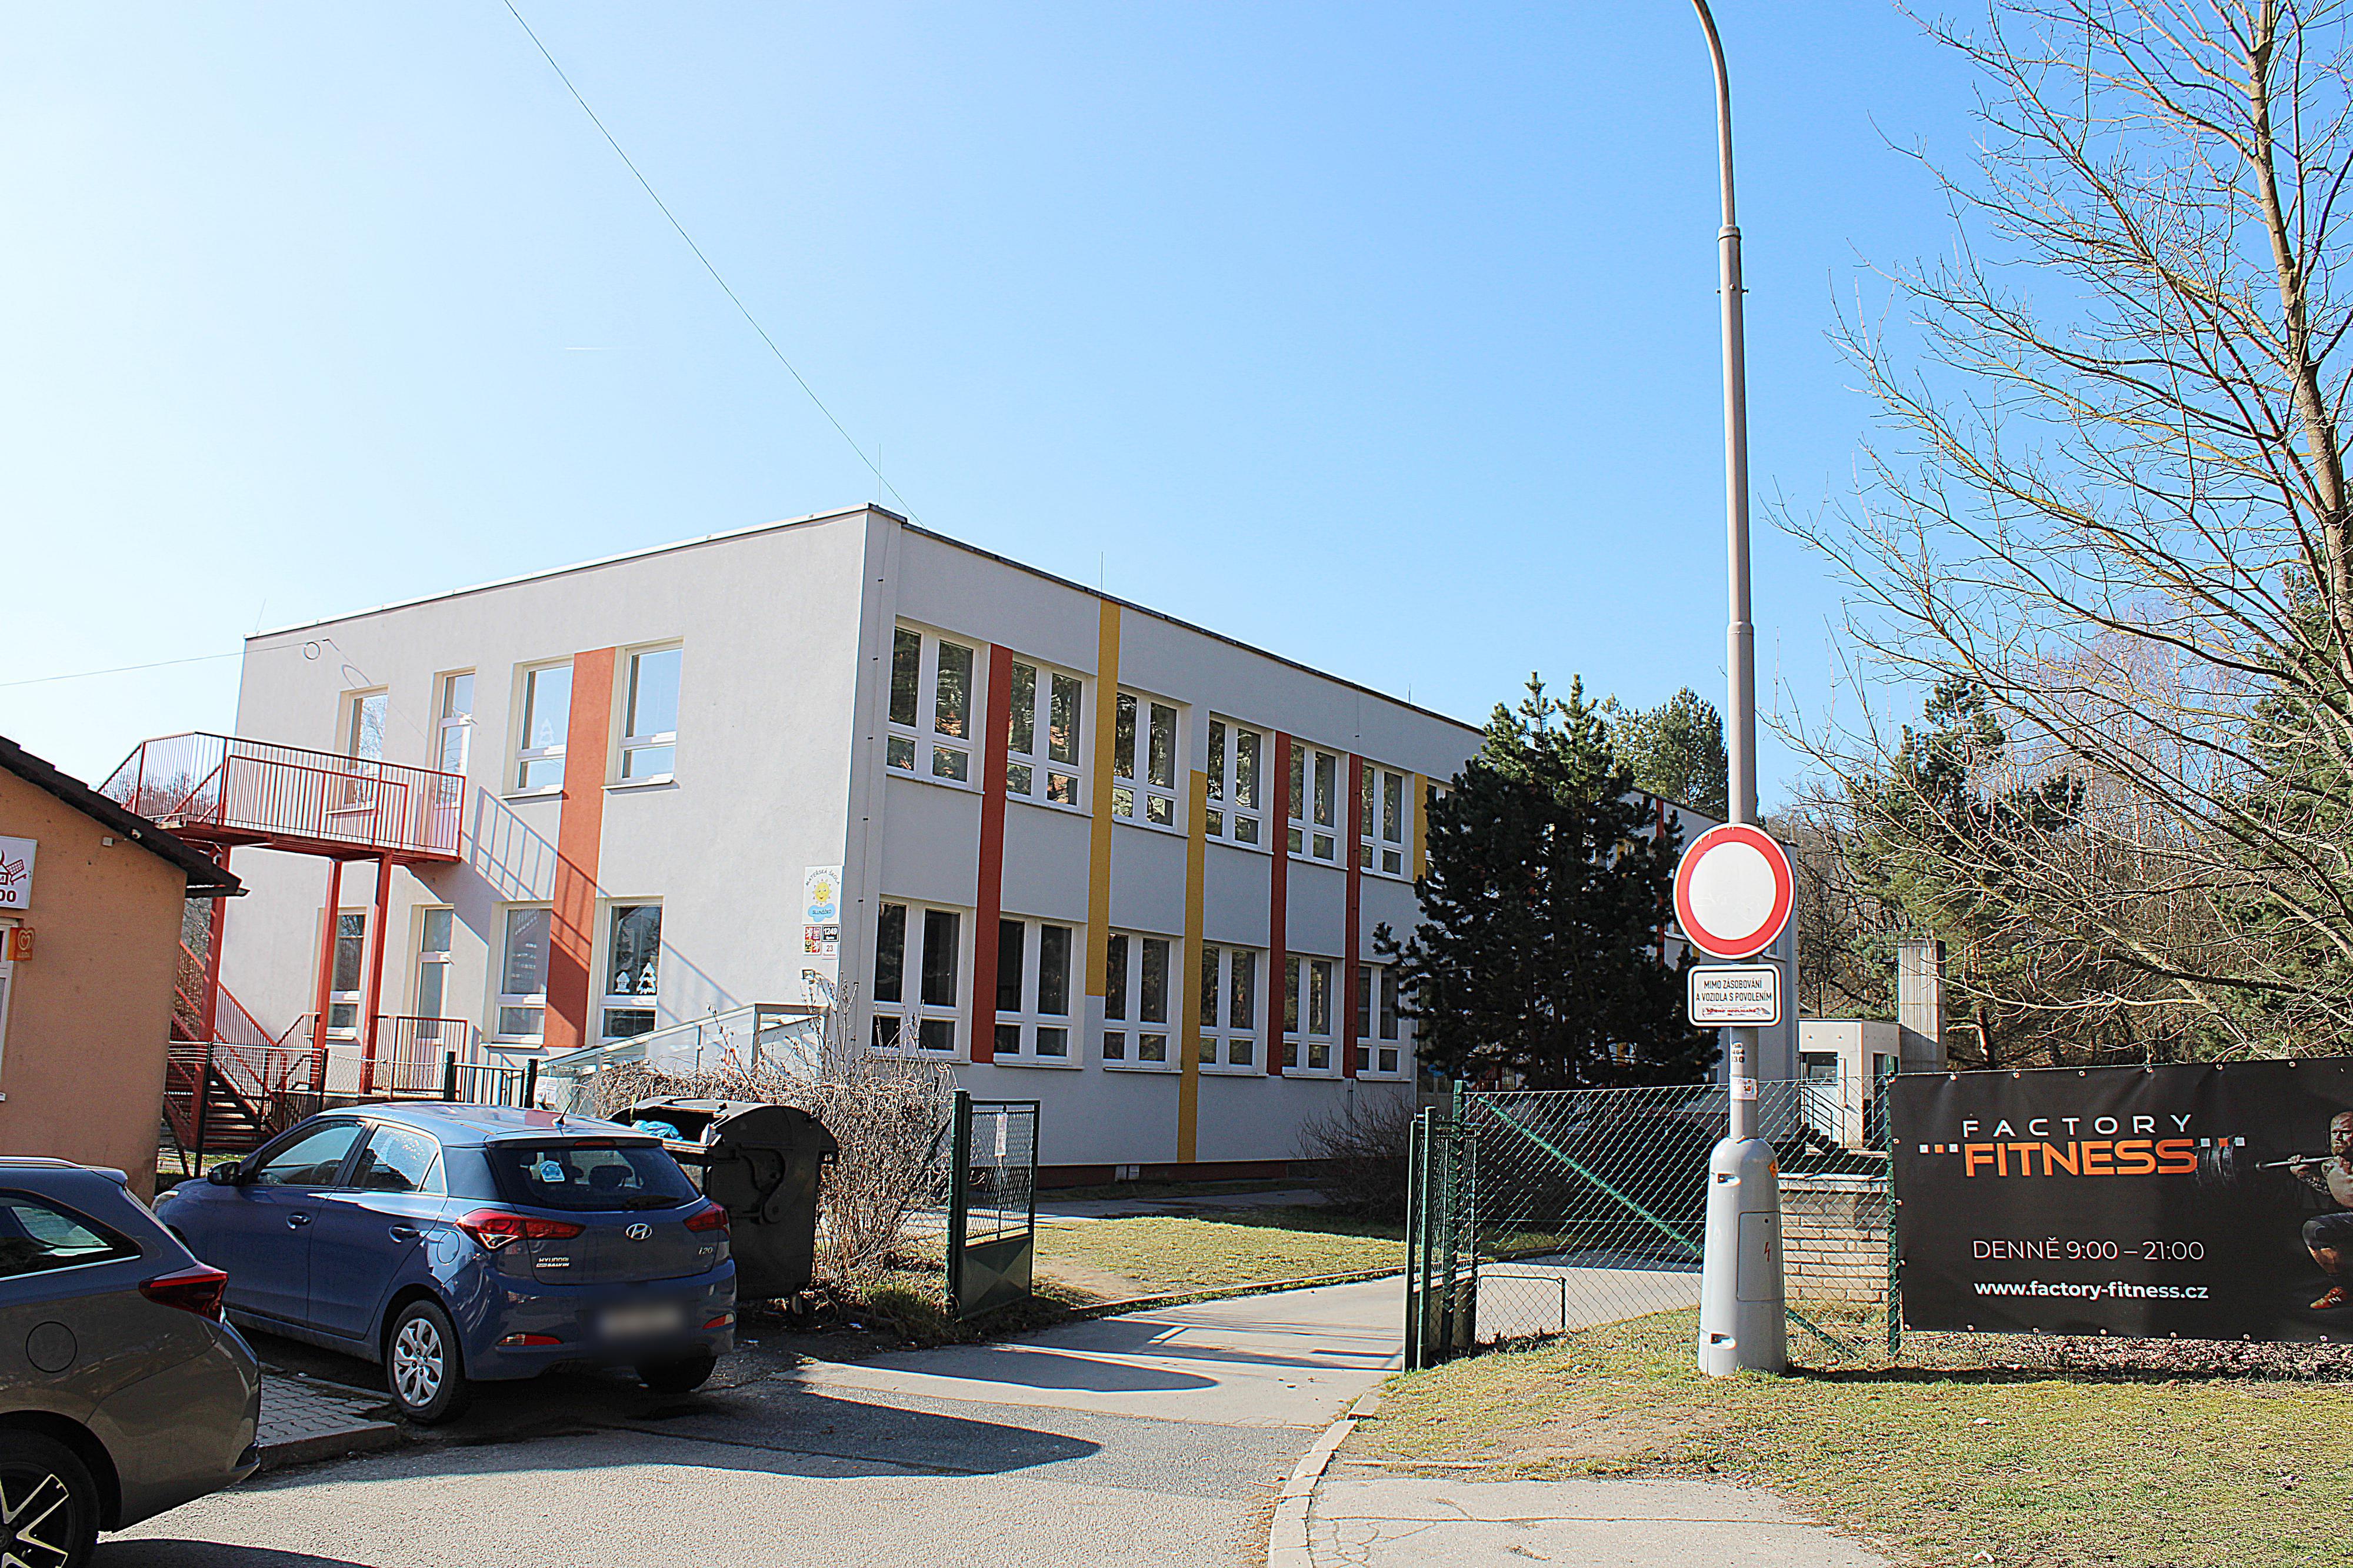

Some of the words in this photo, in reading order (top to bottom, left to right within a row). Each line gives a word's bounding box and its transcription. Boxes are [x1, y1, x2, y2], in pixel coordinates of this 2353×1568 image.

[806, 868, 828, 886] MATEŘSKÁ
[828, 870, 840, 885] ŠKOLA
[824, 927, 837, 935] 1249
[1704, 980, 1721, 989] MIMO
[1723, 978, 1762, 989] ZÁSOBOVÁNÍ
[1696, 992, 1700, 1001] A
[1702, 992, 1727, 1001] VOZIDLA
[1729, 992, 1734, 1001] S
[1735, 990, 1772, 1001] POVOLENÍM
[1963, 1115, 2191, 1137] FACTORY
[1964, 1139, 2198, 1177] FITNESS
[1973, 1237, 2061, 1259] DENNĚ
[2067, 1241, 2118, 1260] 9:00
[2142, 1242, 2205, 1260] 21:00
[1974, 1280, 2209, 1300] www.factory-fitness.cz
